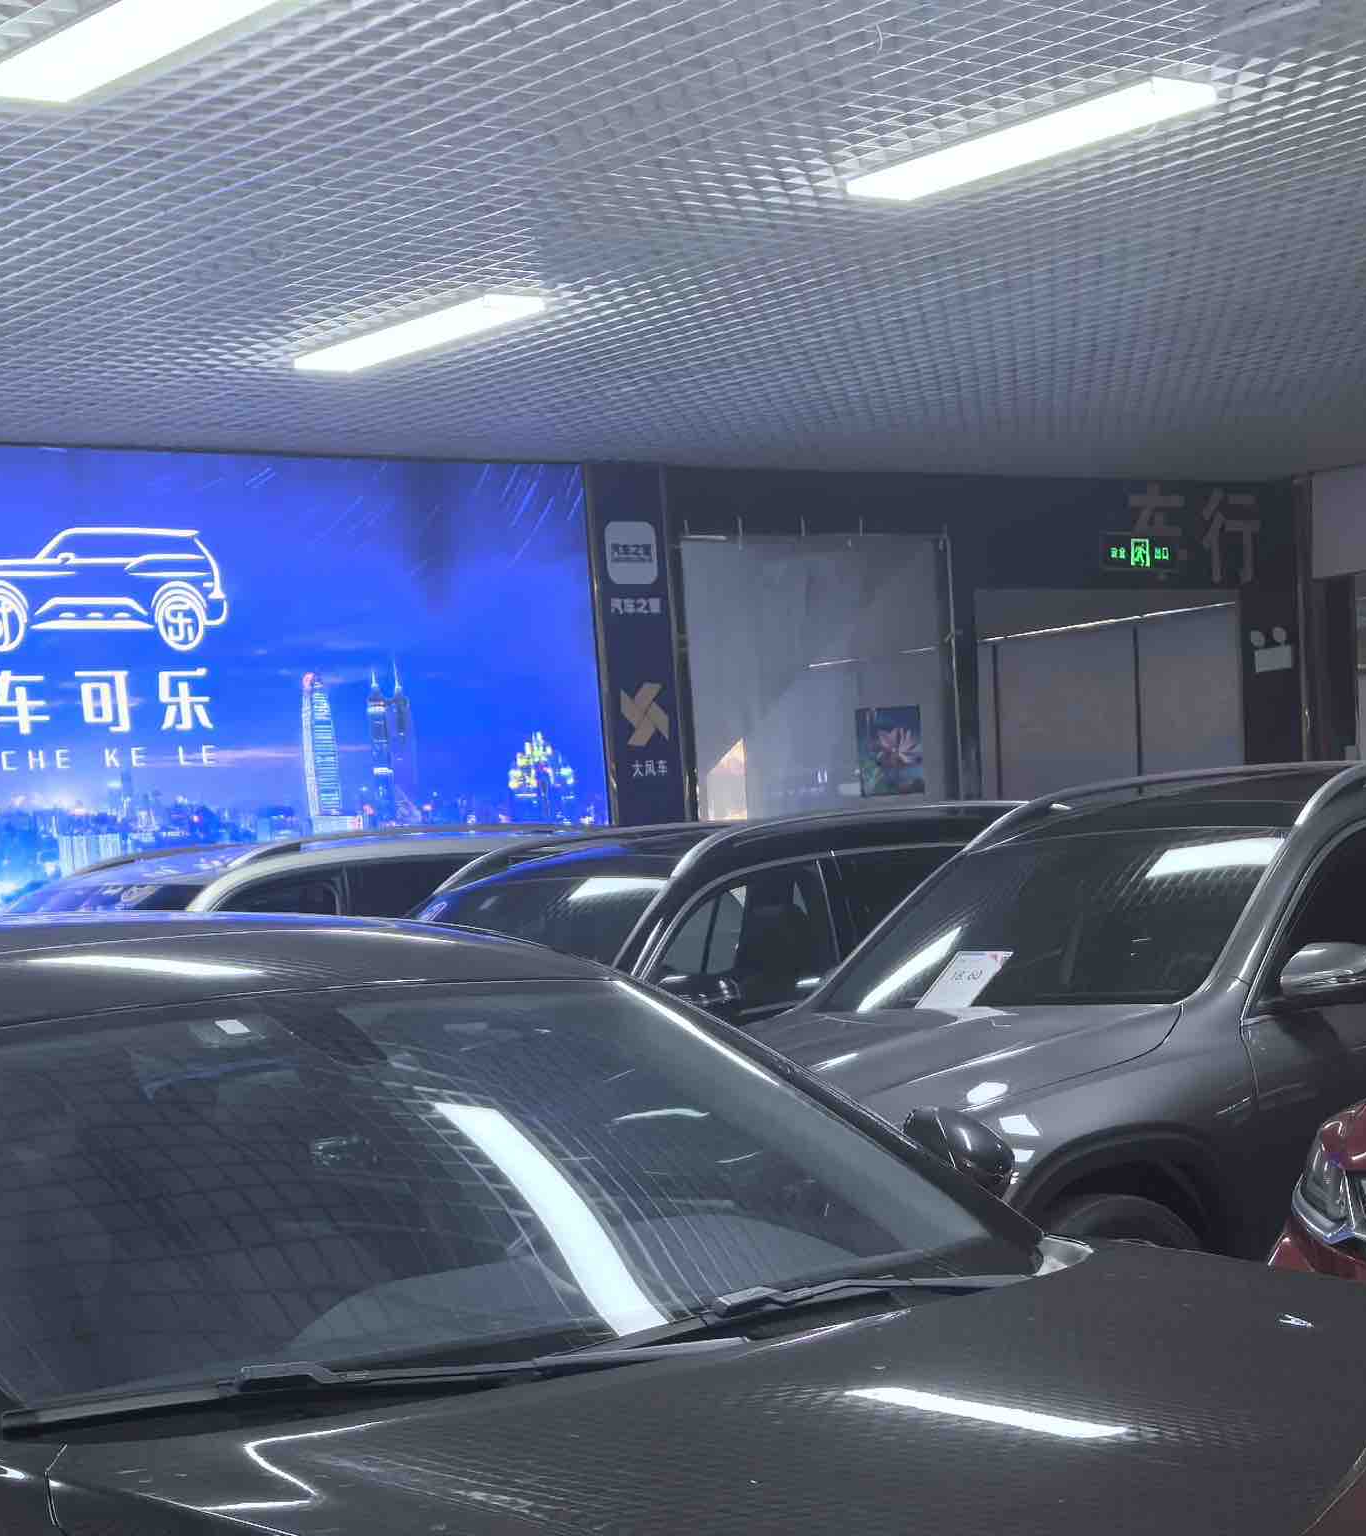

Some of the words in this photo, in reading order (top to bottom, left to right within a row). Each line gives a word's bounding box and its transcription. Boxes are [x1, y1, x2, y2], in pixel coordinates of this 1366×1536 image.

[1, 748, 72, 771] CHE
[104, 746, 148, 769] KE
[178, 744, 216, 767] LE
[631, 759, 669, 777] 大风车
